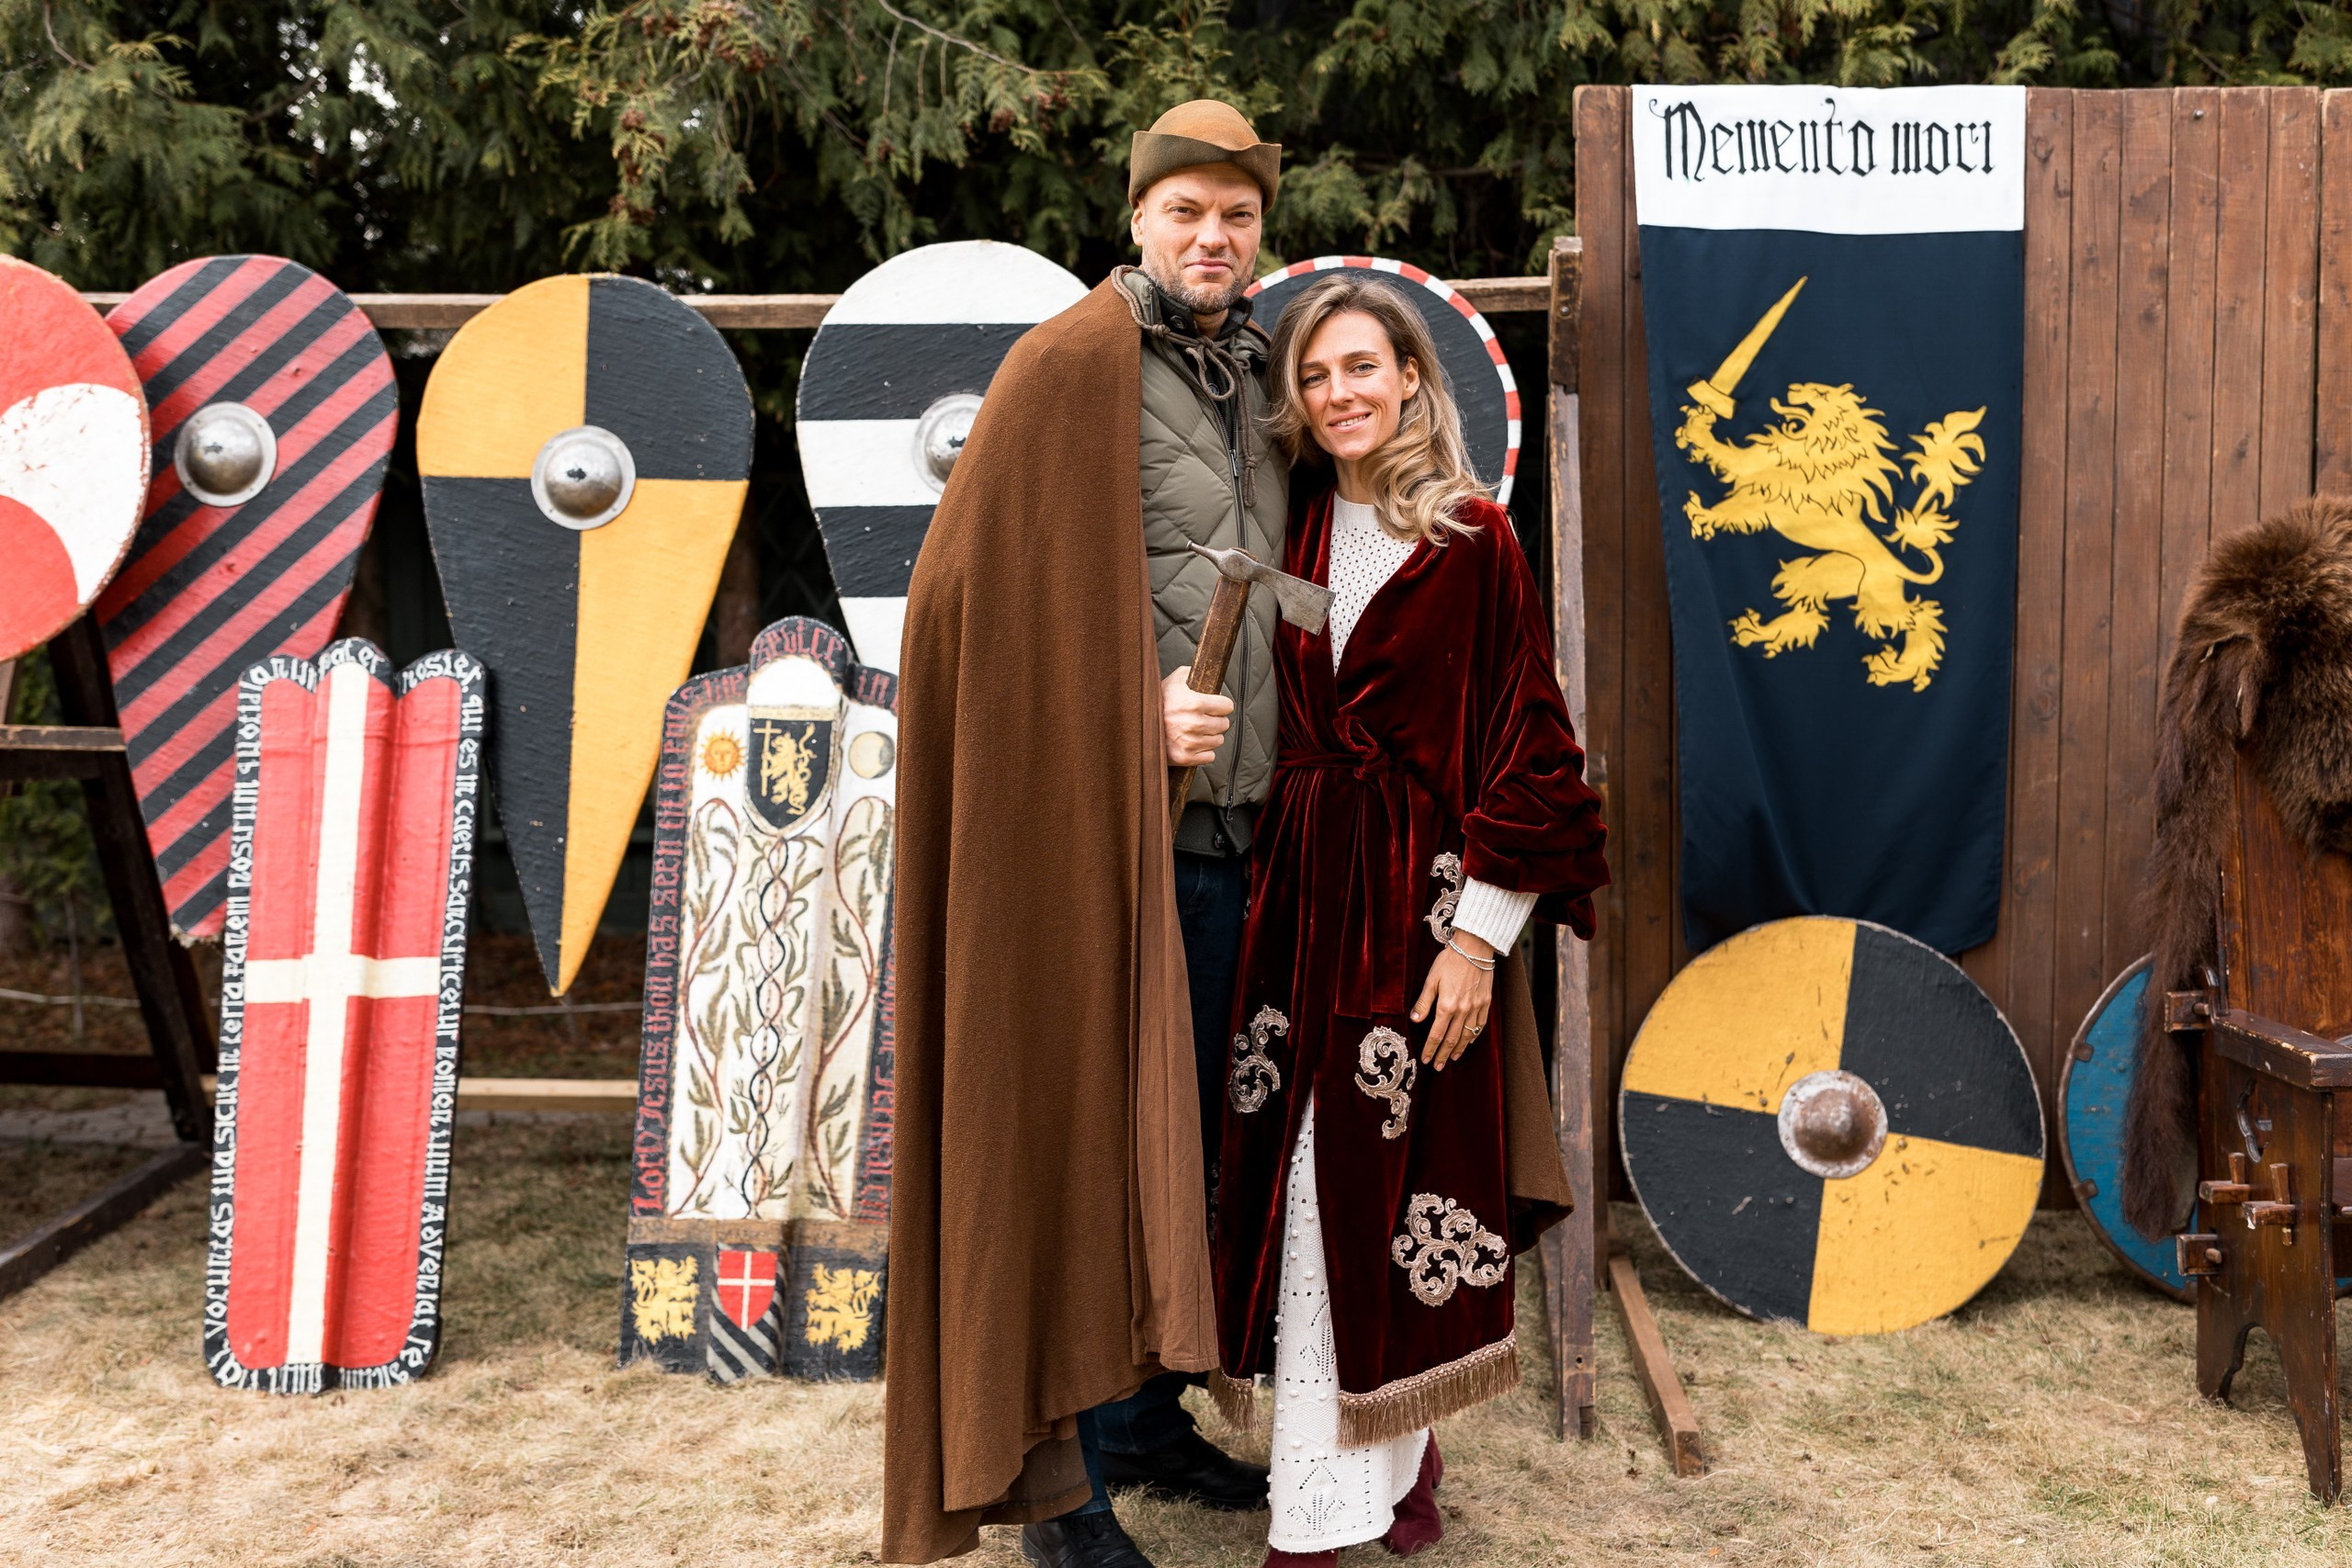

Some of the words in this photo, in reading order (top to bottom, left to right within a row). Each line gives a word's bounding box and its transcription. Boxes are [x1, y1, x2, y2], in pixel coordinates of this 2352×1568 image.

[1649, 97, 1877, 183] Memento
[1891, 119, 1996, 175] mori
[318, 638, 385, 681] pater
[461, 694, 483, 732] qui
[458, 738, 479, 770] es
[659, 762, 688, 791] to
[455, 773, 479, 797] in
[227, 779, 261, 888] nostrum
[651, 839, 683, 907] seen
[649, 915, 679, 968] has
[644, 975, 675, 1033] thou
[215, 1048, 241, 1073] in
[430, 1047, 458, 1126] nomen
[424, 1130, 451, 1197] tuum
